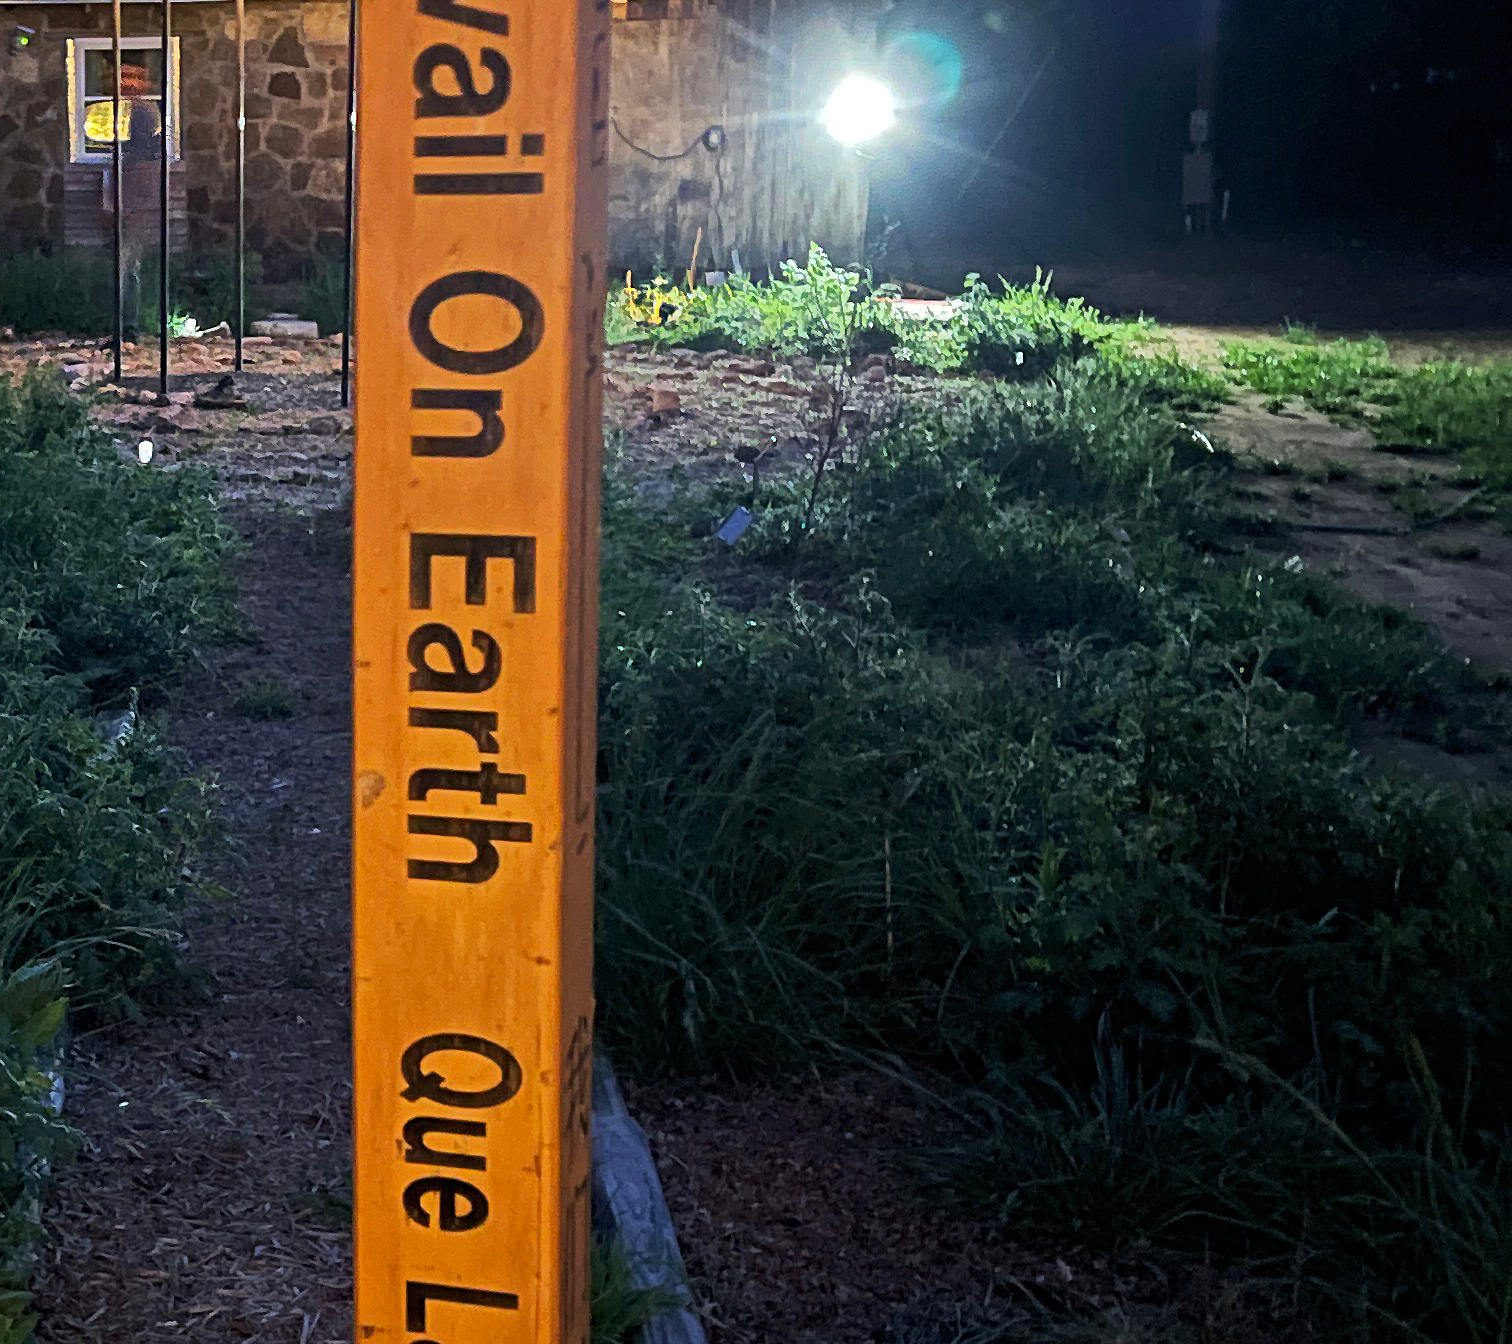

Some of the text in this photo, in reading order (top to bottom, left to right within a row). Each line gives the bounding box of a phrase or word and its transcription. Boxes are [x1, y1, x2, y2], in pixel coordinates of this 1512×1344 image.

[409, 271, 543, 457] On
[408, 533, 536, 883] Earth
[400, 1034, 522, 1232] Que
